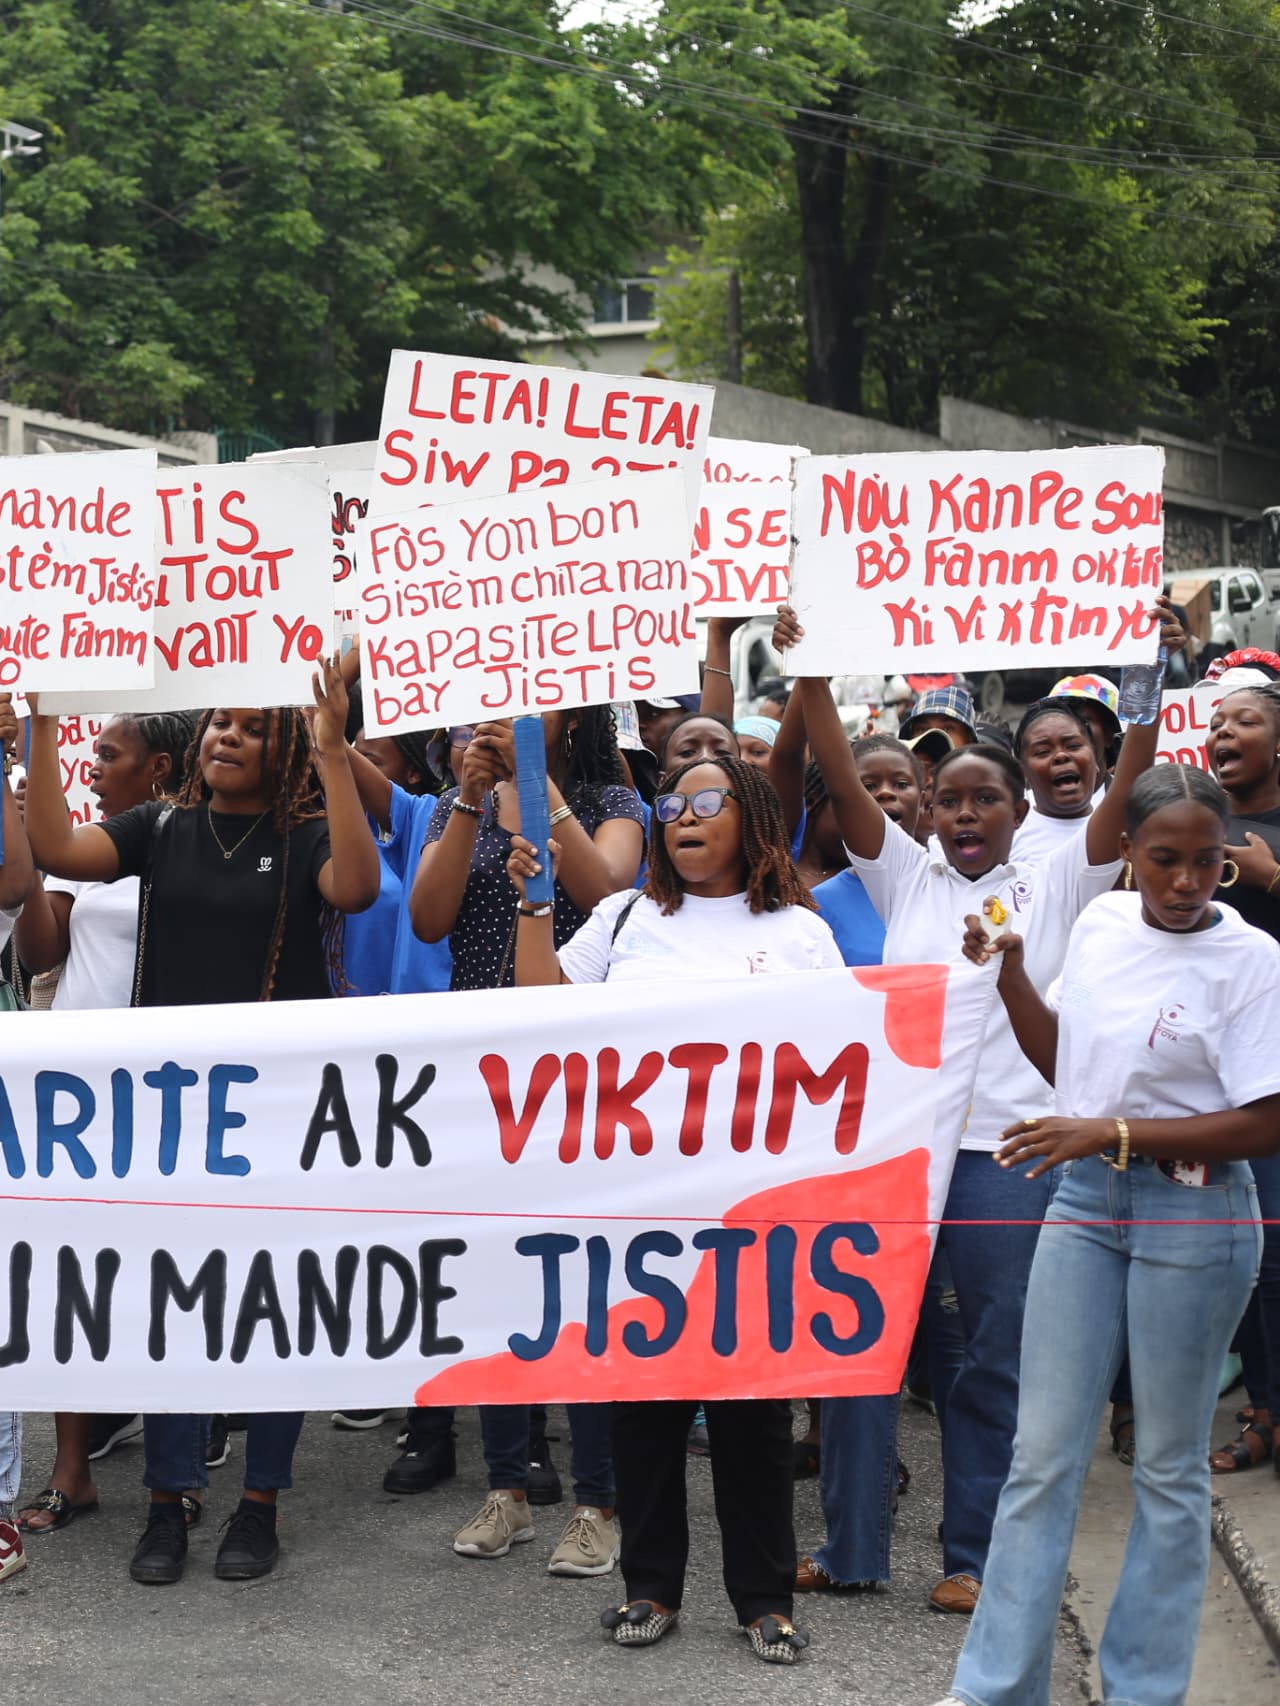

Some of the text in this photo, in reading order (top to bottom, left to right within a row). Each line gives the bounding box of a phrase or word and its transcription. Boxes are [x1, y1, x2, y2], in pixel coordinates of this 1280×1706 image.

[408, 359, 700, 451] LETA! LETA!
[380, 429, 490, 486] Siw
[724, 508, 787, 549] SE
[928, 470, 1084, 534] KanPe
[370, 521, 446, 574] Fòs
[460, 516, 538, 562] Yon
[547, 499, 639, 546] bon
[856, 532, 911, 589] Bò
[924, 536, 1058, 588] Fanm
[60, 611, 149, 668] Fanm
[273, 613, 324, 664] Yo
[882, 597, 934, 647] Ki
[373, 656, 656, 727] bay JiSTiS
[300, 1053, 436, 1170] AK
[478, 1041, 870, 1164] VIKTIM
[148, 1238, 467, 1364] MANDE
[507, 1221, 885, 1361] JISTIS
